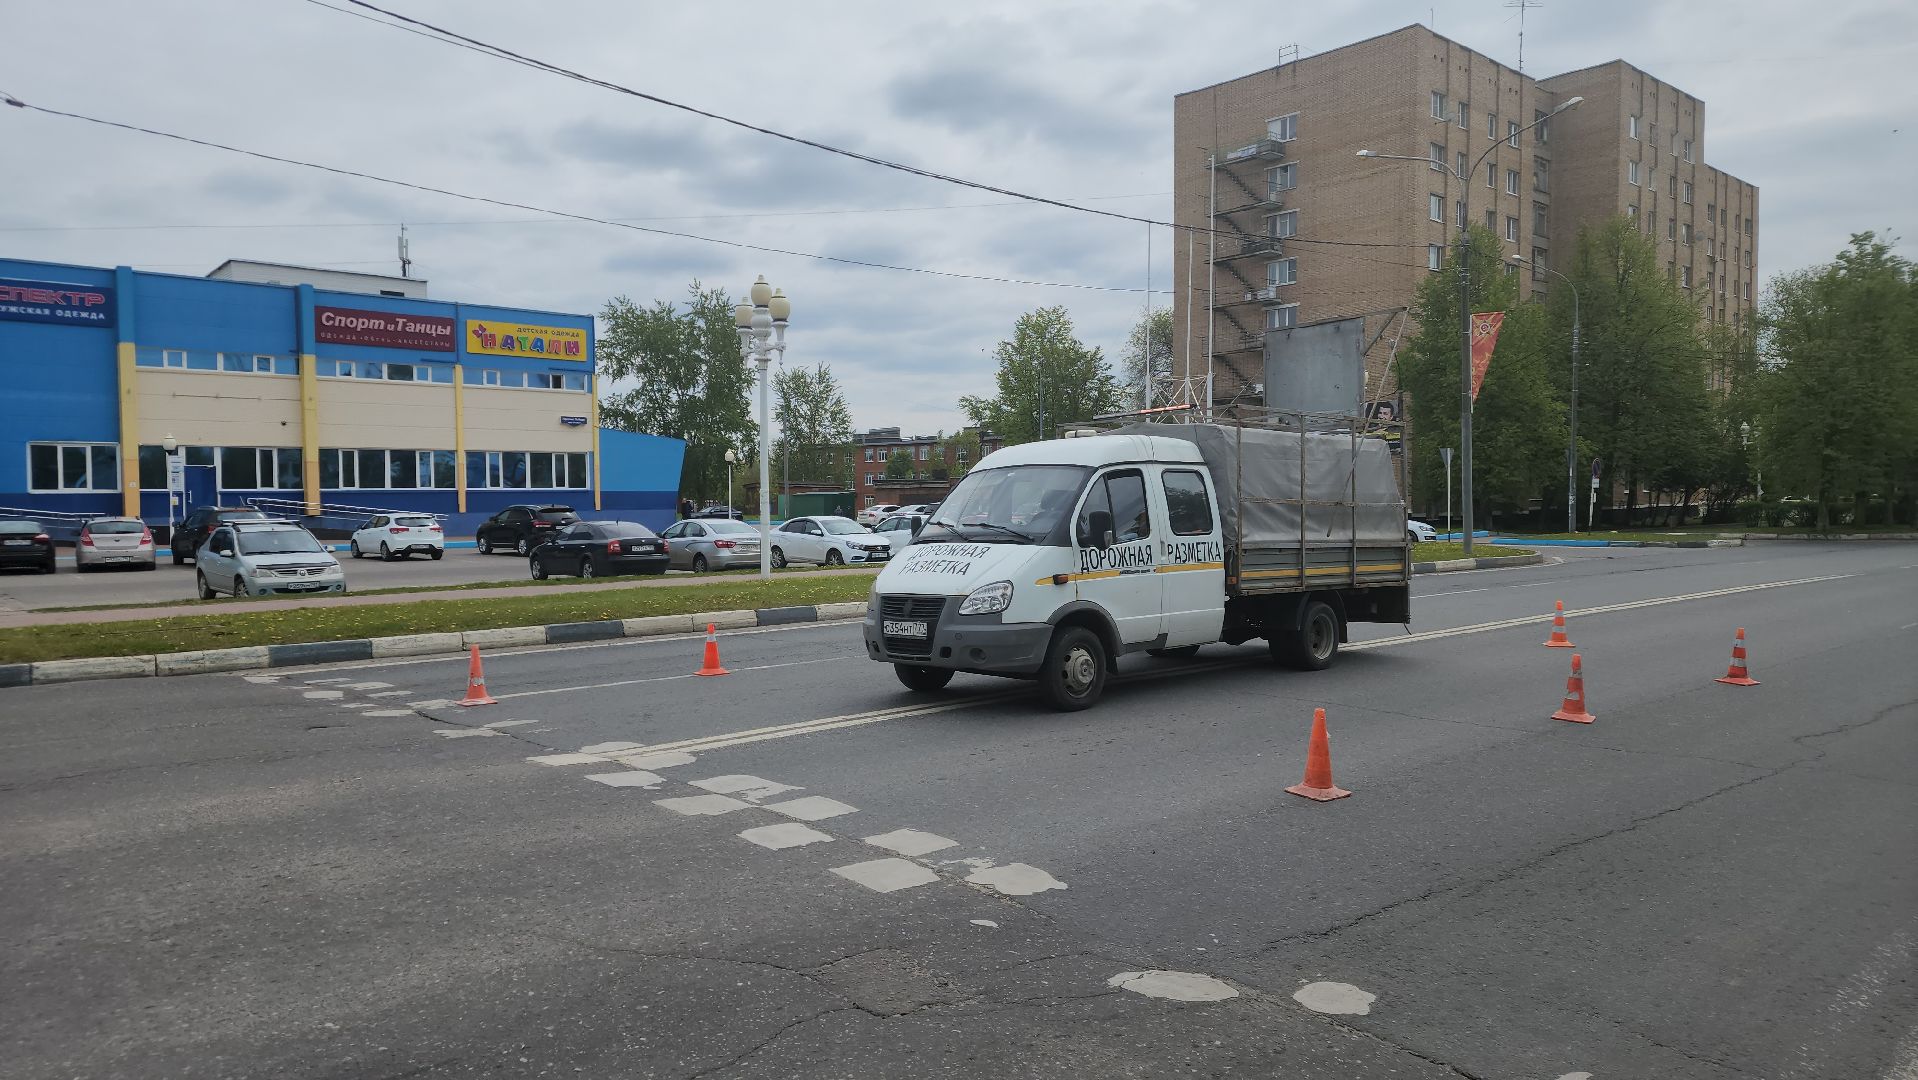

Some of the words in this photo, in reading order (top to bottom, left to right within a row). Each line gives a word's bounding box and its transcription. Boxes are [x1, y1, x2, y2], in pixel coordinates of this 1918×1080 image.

[55, 309, 105, 319] ОДЕЖДА
[321, 311, 385, 331] Спорт
[395, 318, 451, 337] Танцы
[482, 333, 580, 355] НАТАЛИ
[907, 544, 991, 561] ДОРОЖНАЯ
[1080, 544, 1153, 575] ДОРОЖНАЯ
[1167, 541, 1222, 564] РАЗМЕТКА
[898, 559, 971, 576] РАЗМЕТКА
